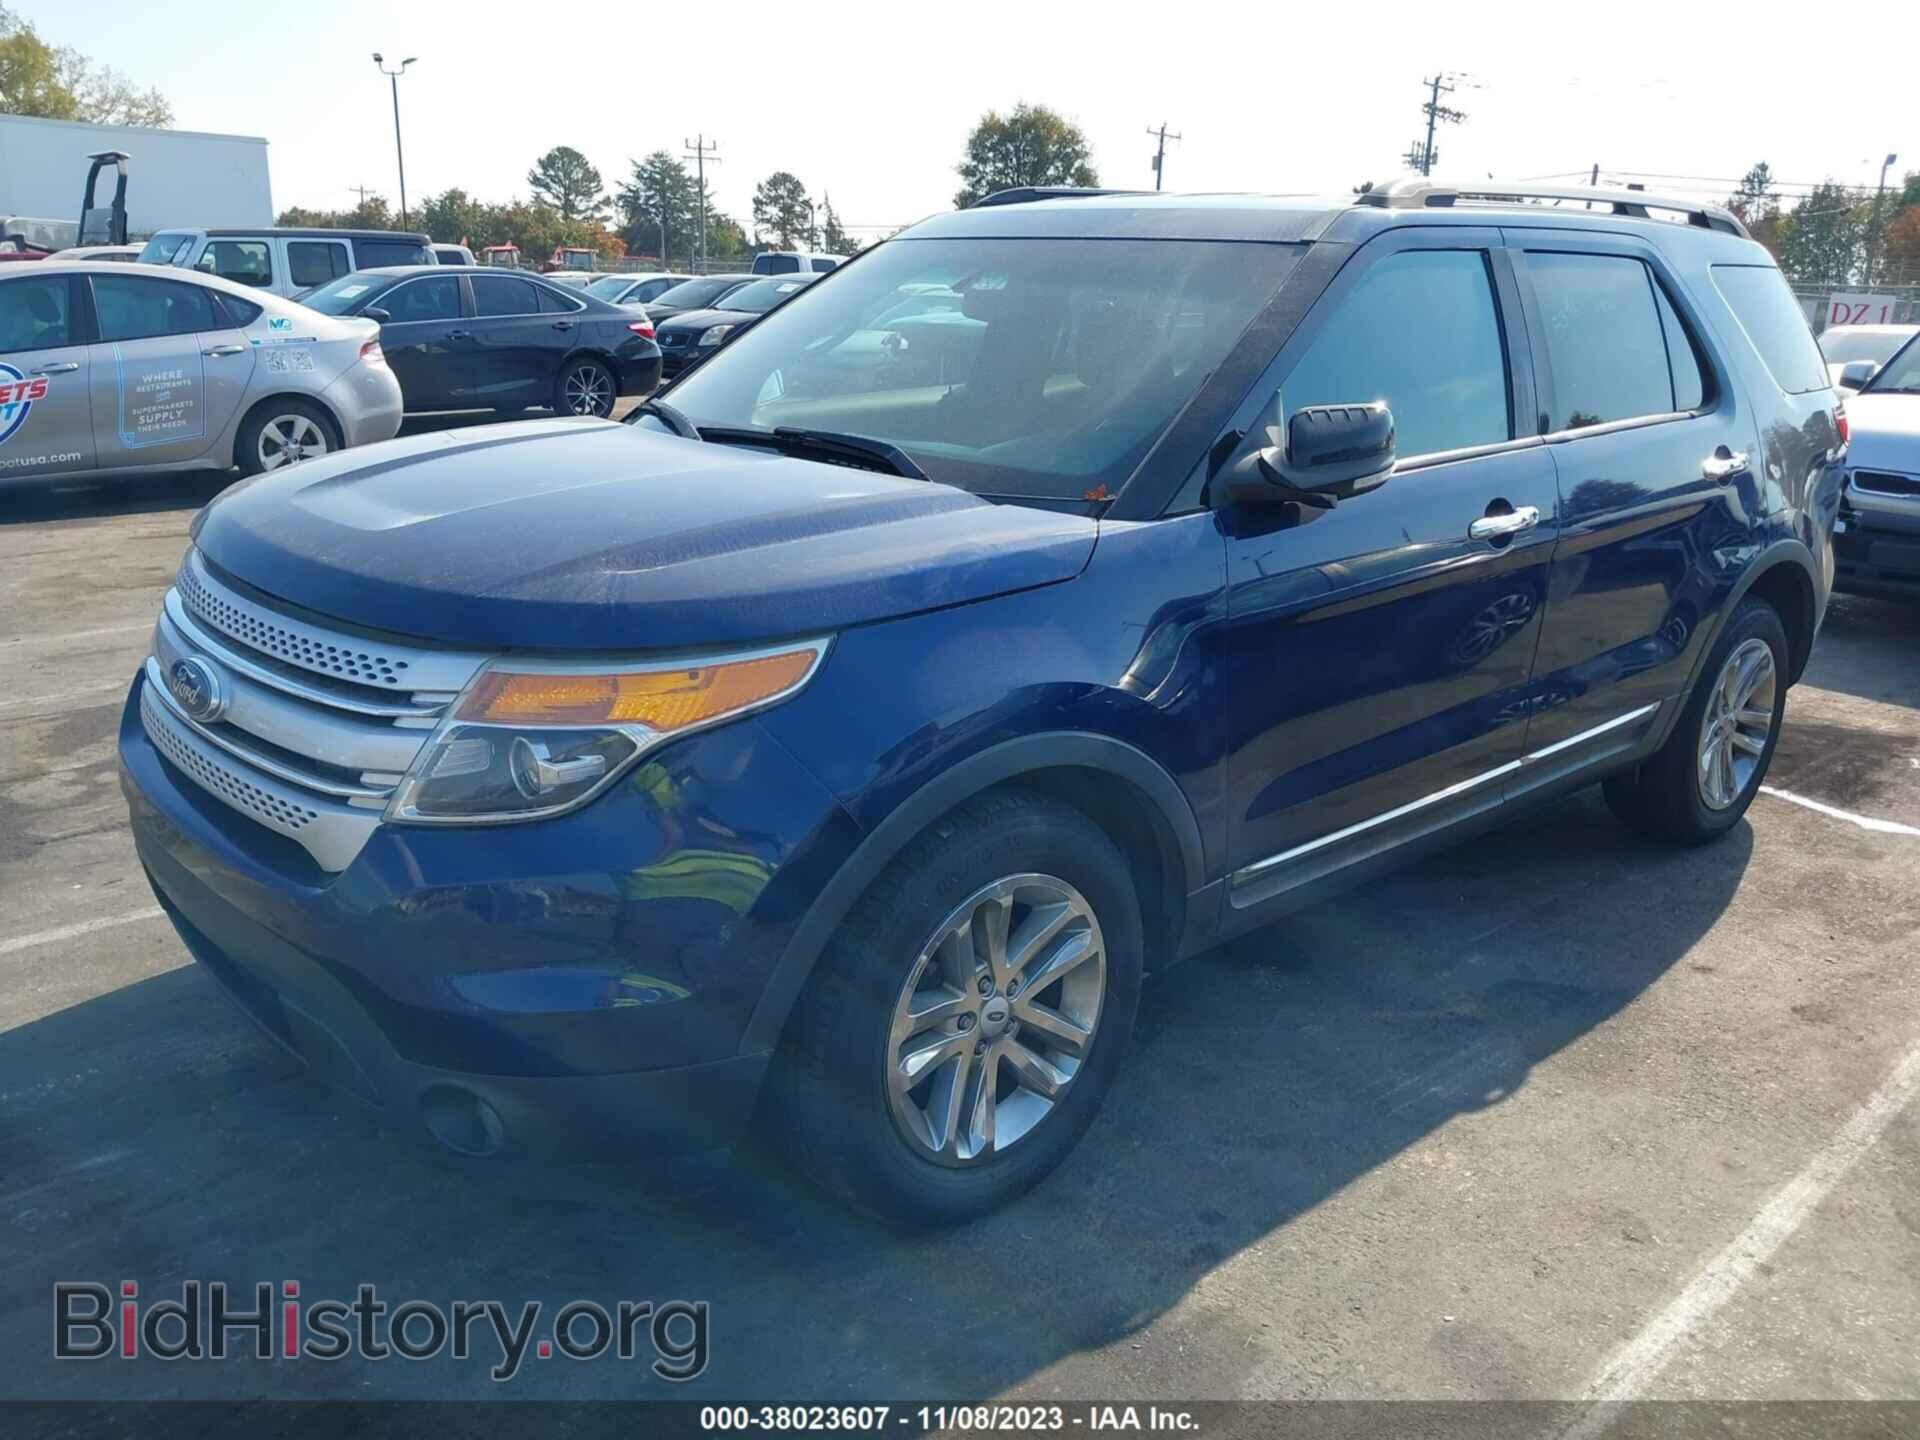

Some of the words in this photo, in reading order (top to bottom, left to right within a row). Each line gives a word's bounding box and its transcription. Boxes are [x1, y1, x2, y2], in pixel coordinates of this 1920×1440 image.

[1830, 302, 1872, 325] DZ
[142, 369, 184, 384] WHERE
[132, 399, 194, 416] SUPERMARKETS
[138, 409, 184, 425] SUPPLY
[170, 664, 202, 706] Ford
